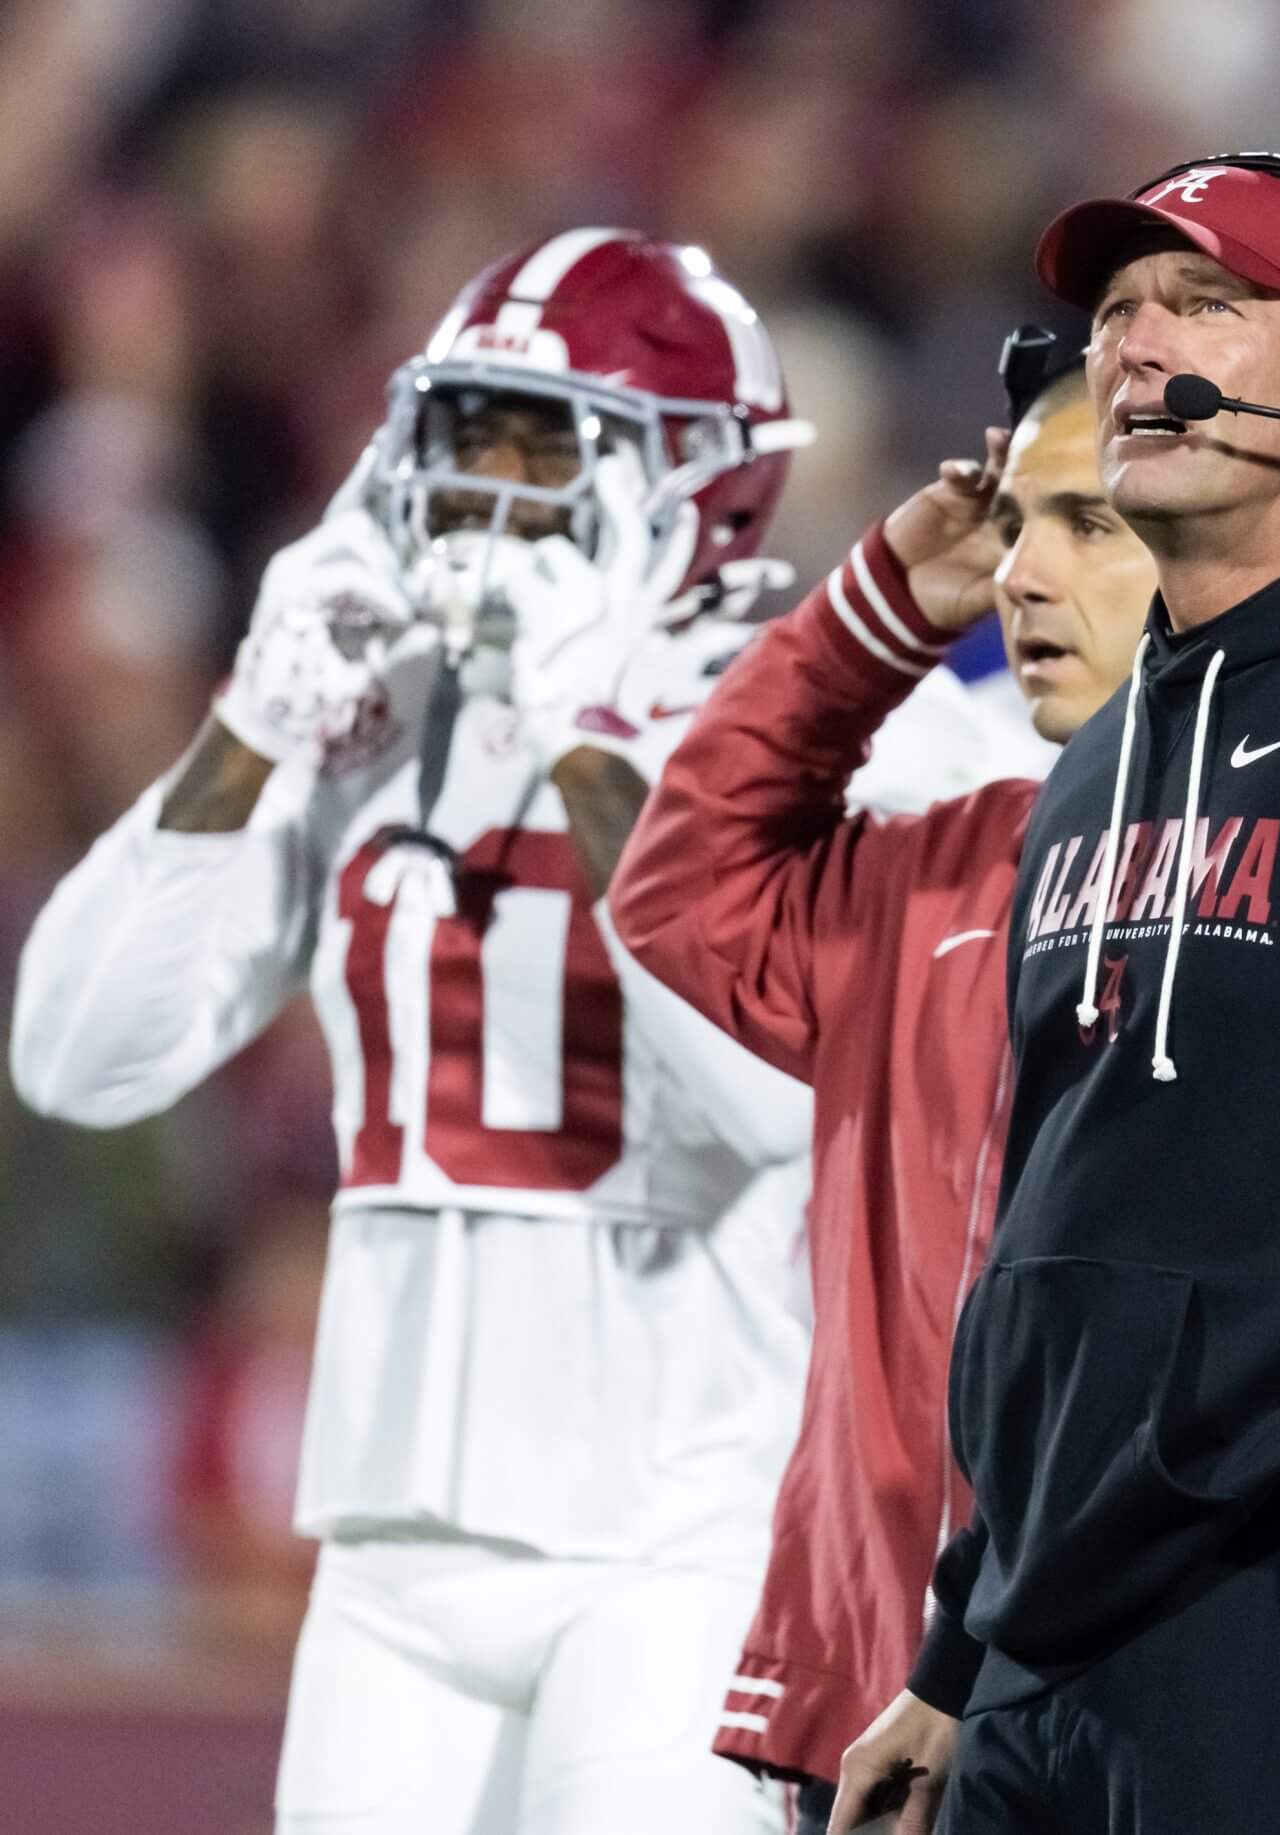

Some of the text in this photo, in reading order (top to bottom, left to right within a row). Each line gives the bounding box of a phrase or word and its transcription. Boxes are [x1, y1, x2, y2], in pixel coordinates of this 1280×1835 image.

[339, 824, 625, 1192] 10
[1058, 933, 1079, 948] FOR
[1105, 923, 1171, 941] UNIVERSITY
